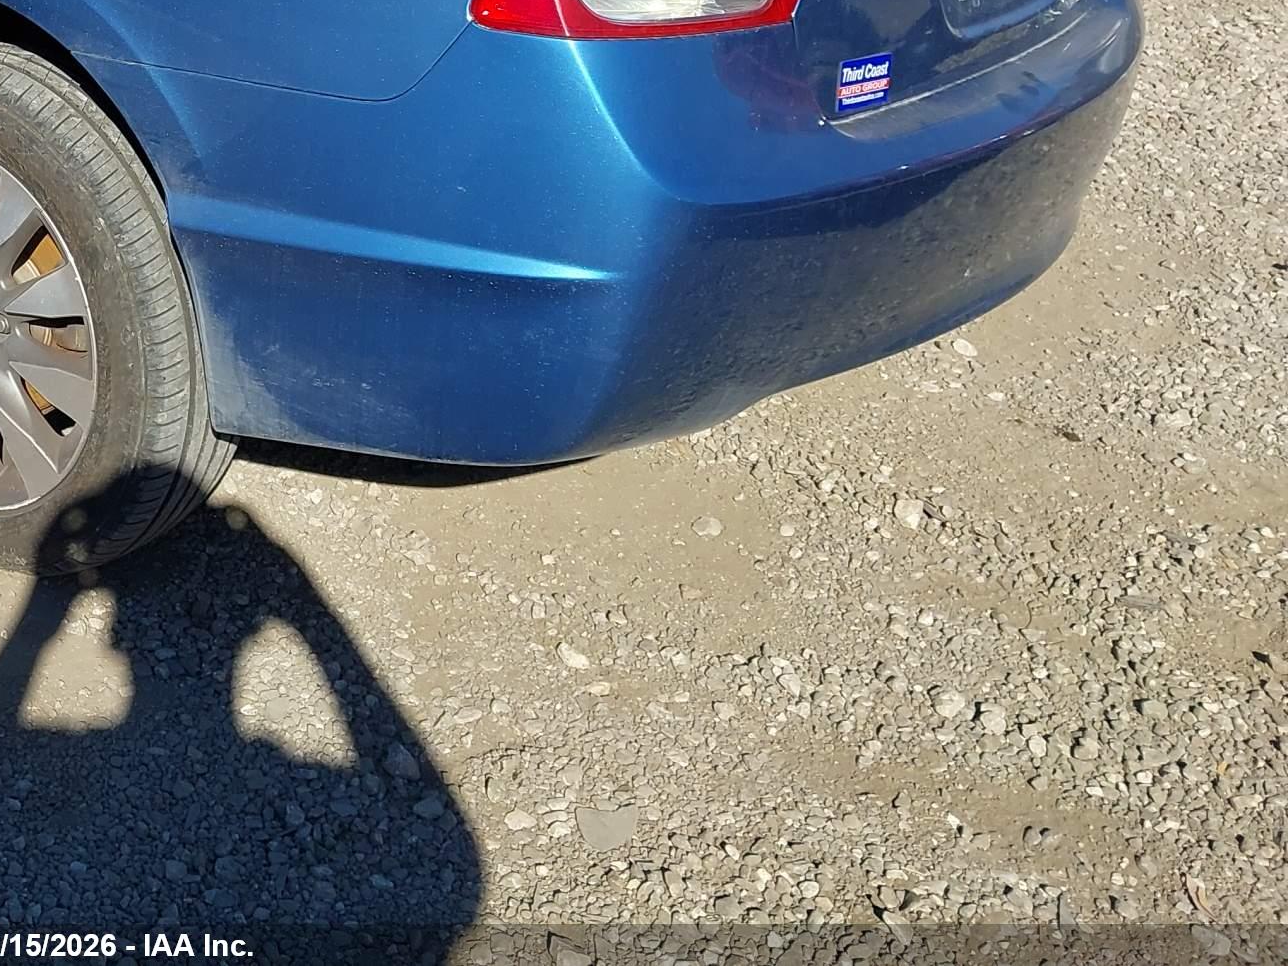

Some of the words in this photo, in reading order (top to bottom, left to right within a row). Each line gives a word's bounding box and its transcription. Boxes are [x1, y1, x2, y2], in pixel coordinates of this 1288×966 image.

[842, 65, 865, 83] Third
[865, 61, 889, 79] Coast
[840, 85, 861, 96] AUTO
[862, 79, 888, 92] GROUP
